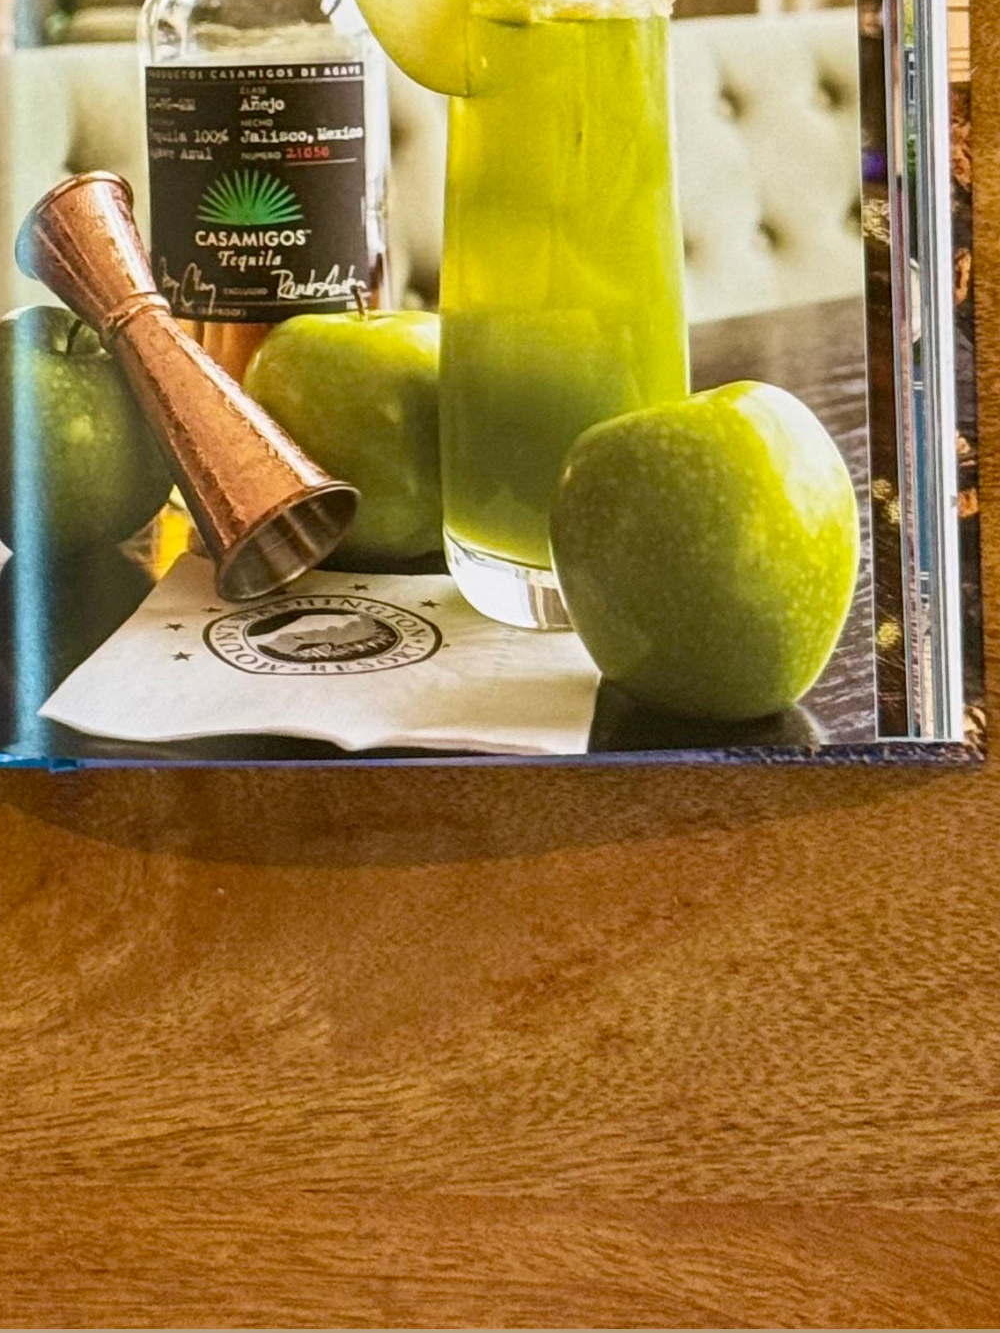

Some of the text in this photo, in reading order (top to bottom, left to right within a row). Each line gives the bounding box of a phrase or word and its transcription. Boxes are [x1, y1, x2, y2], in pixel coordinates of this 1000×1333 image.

[301, 68, 317, 78] DE
[323, 65, 361, 77] AGAVE
[240, 96, 286, 115] Añejo
[240, 130, 314, 144] Jalisco,
[195, 229, 306, 247] CASAMIGOS
[217, 249, 282, 273] Tequila
